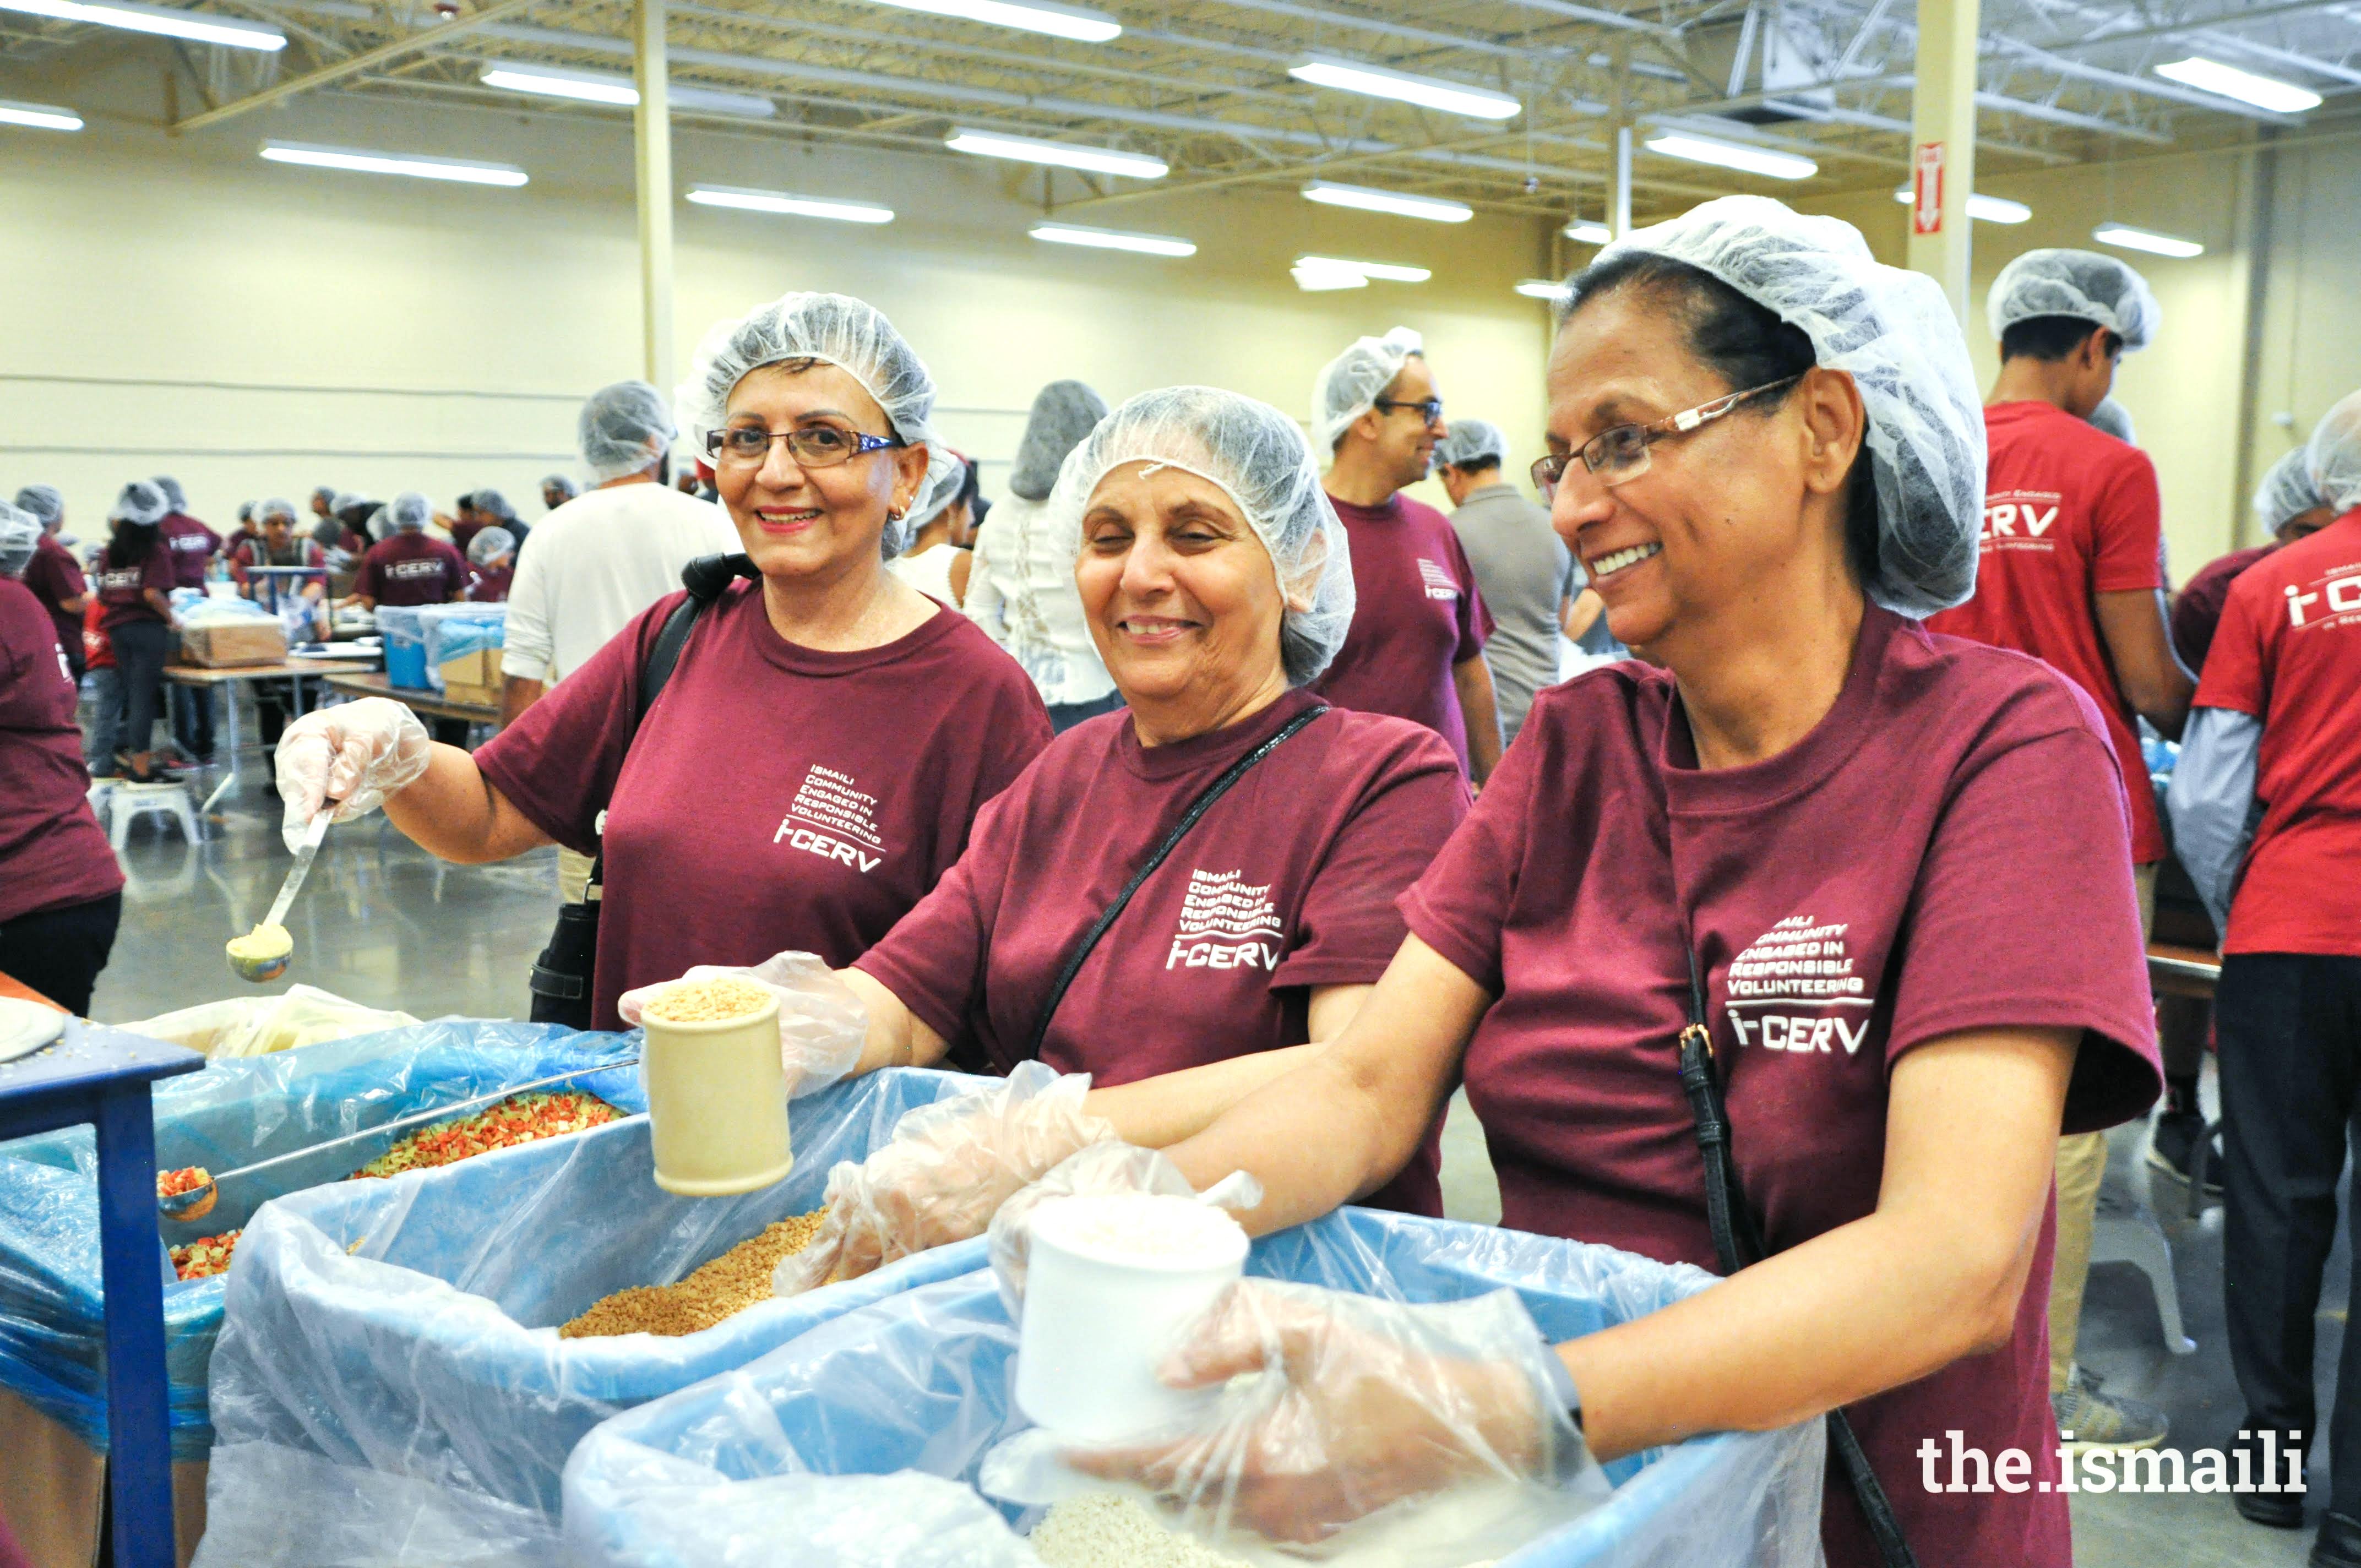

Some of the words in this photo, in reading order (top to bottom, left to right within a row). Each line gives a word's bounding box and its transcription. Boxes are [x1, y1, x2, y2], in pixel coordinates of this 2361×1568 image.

[805, 774, 878, 805] COMMUNITY
[810, 764, 855, 785] ISMAILI
[794, 794, 878, 832] RESPONSIBLE
[799, 784, 858, 809] ENGAGED
[859, 805, 873, 817] IN
[791, 803, 882, 845] VOLUNTEERING
[773, 818, 882, 873] i-CERV
[1184, 894, 1253, 908] ENGAGED
[1755, 923, 1848, 945] OMMUNITY
[1823, 940, 1845, 955] IN
[1166, 940, 1279, 971] i-CERV
[1728, 958, 1854, 977] RESPONSIBLE
[1727, 977, 1864, 996] VOLUNTEERING
[1727, 1009, 1870, 1055] i-CERV
